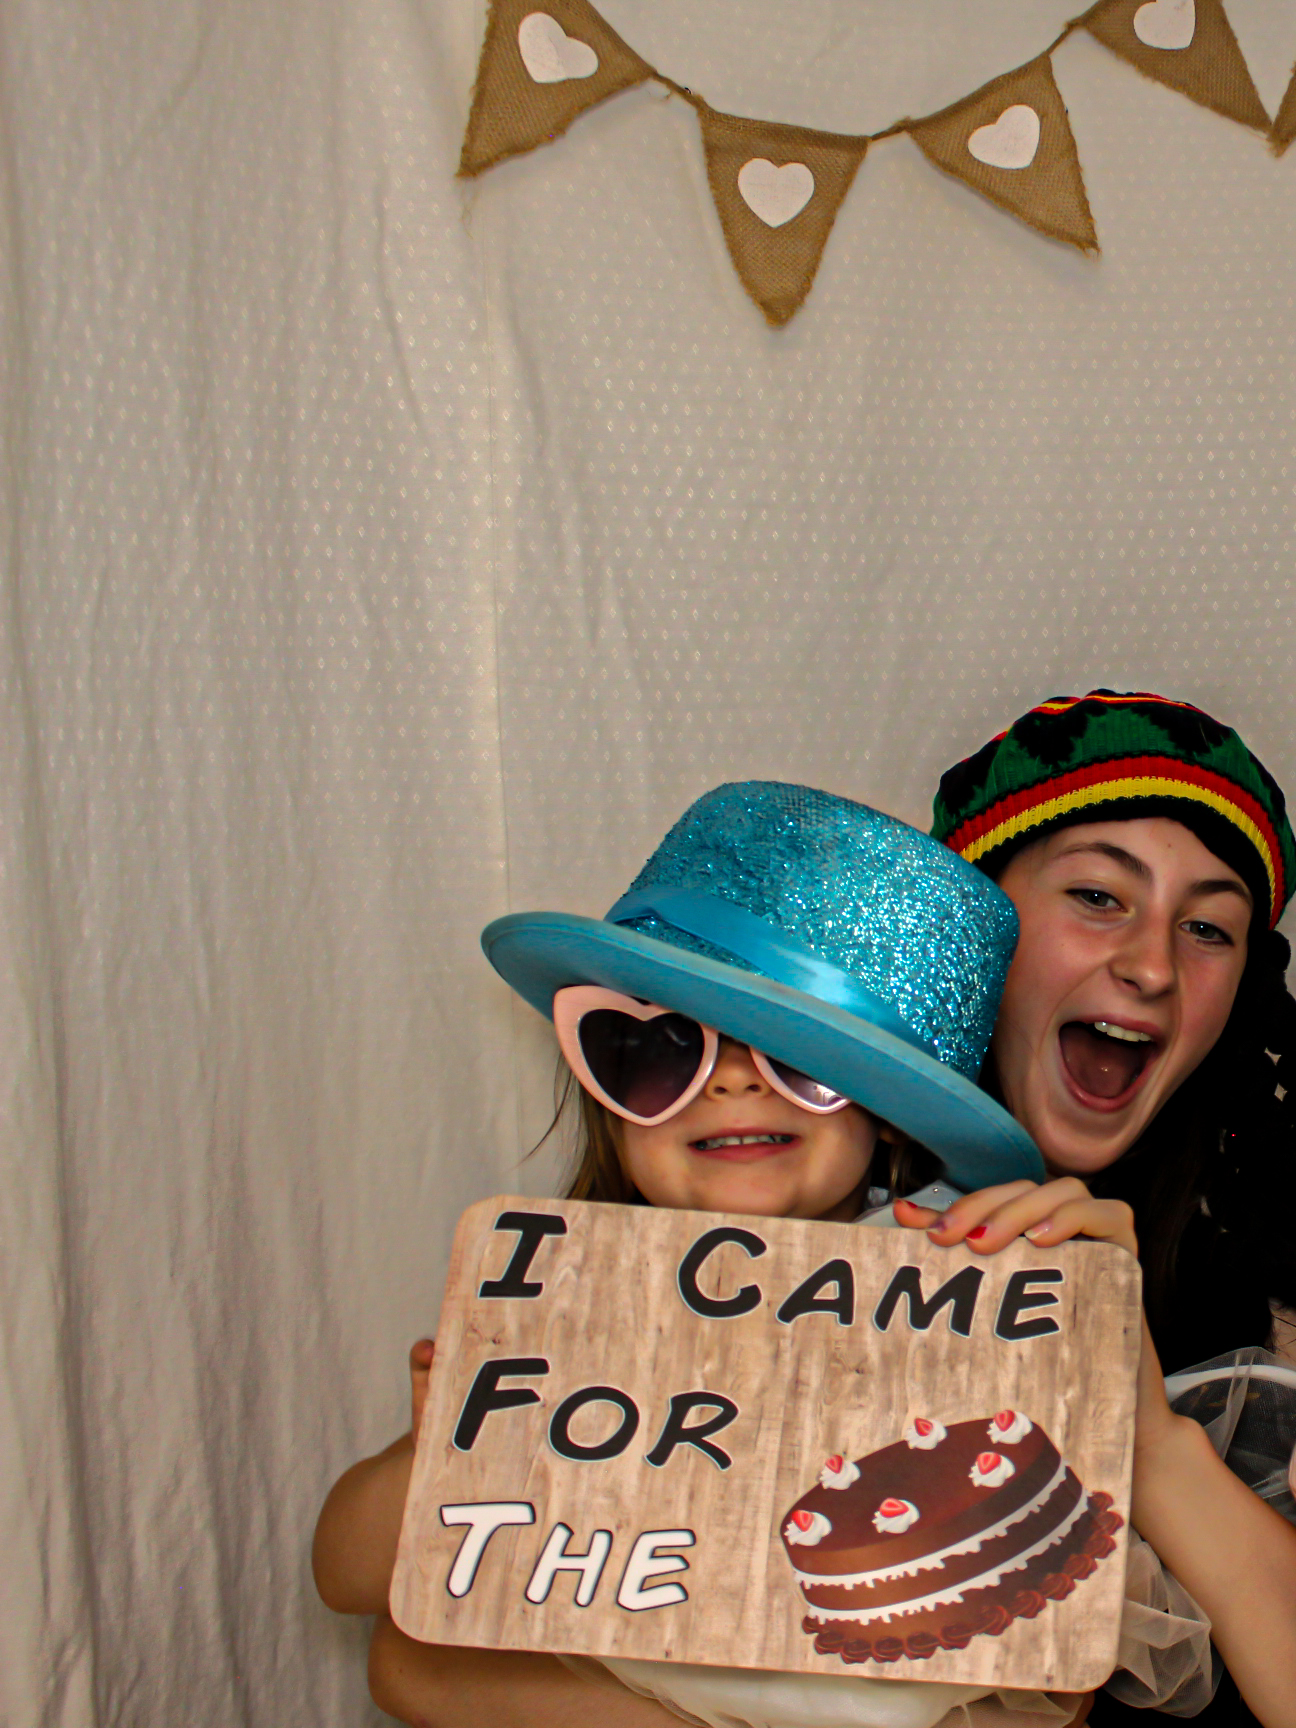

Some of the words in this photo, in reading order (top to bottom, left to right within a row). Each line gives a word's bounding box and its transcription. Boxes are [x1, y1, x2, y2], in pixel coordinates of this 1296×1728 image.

[478, 1211, 567, 1298] I
[677, 1227, 1064, 1341] CAME
[453, 1357, 739, 1471] FOR
[440, 1502, 696, 1612] THE
